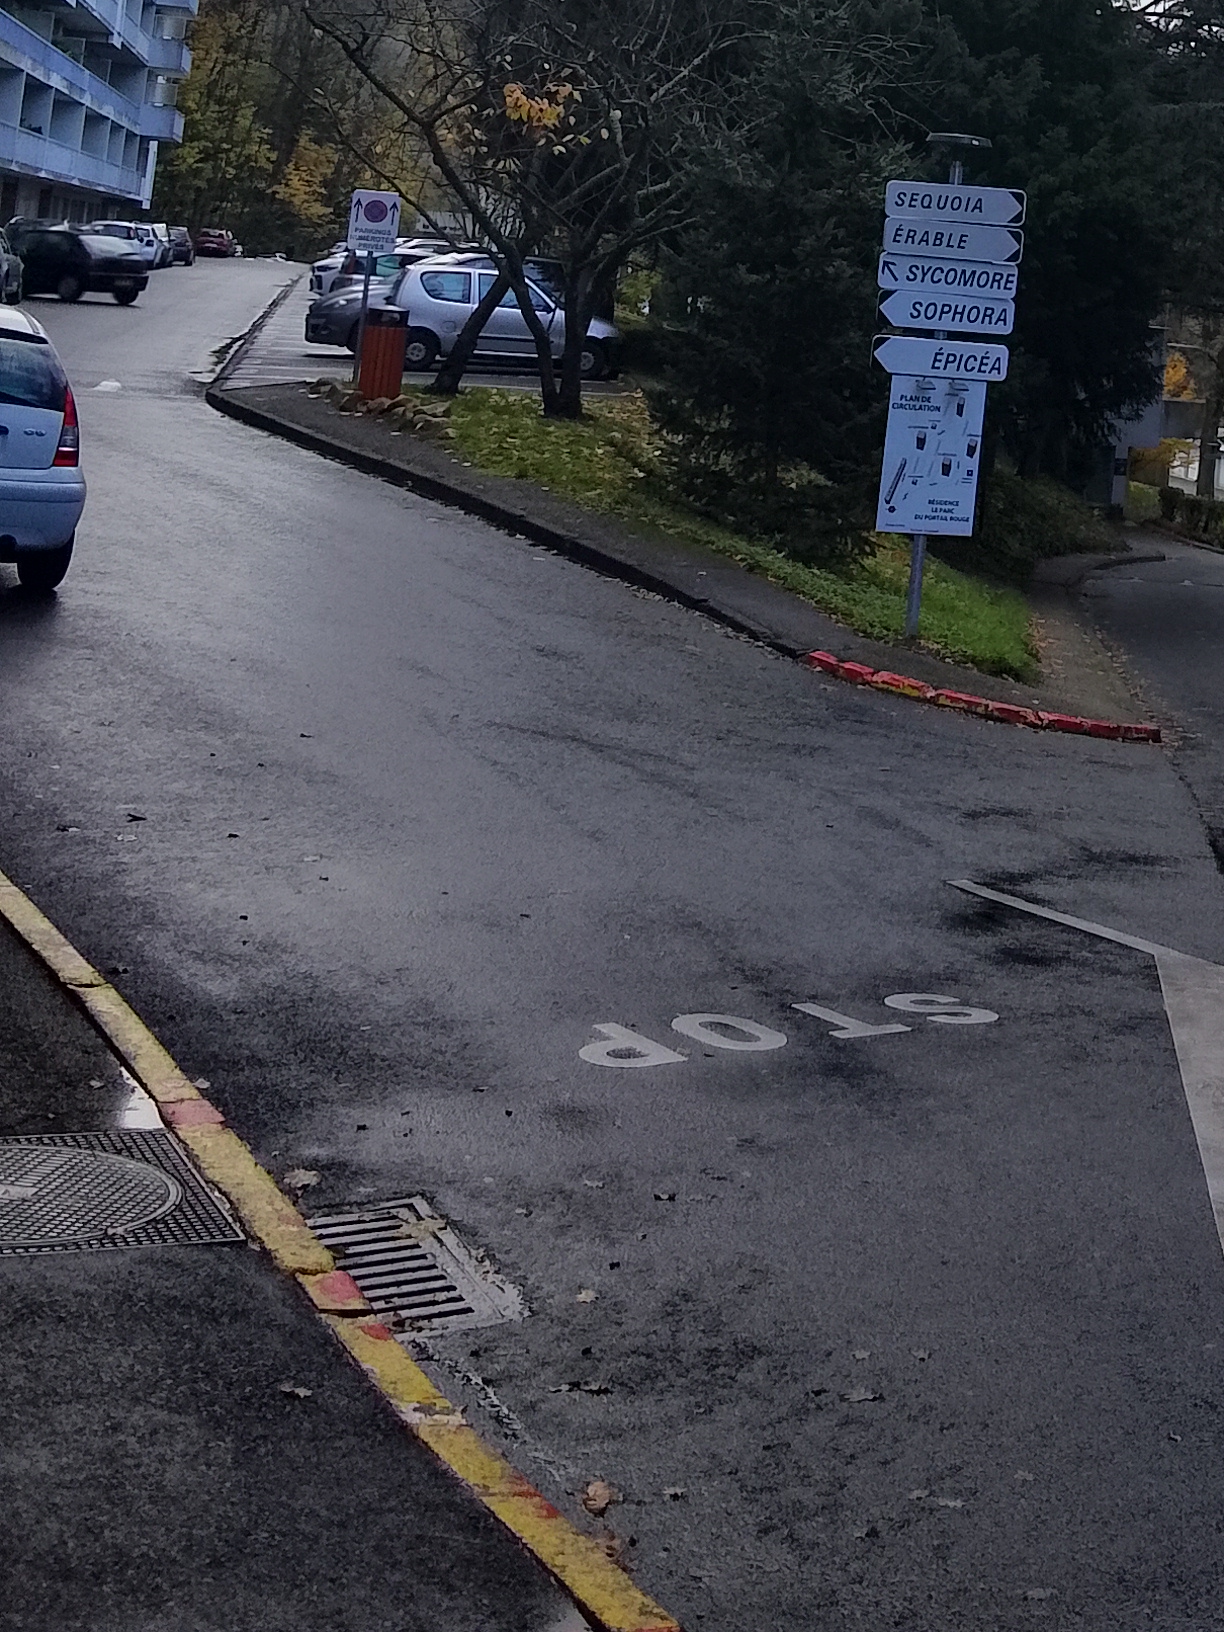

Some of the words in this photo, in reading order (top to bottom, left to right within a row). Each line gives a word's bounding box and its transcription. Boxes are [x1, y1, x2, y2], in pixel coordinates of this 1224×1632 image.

[894, 192, 983, 213] SEQUOIA
[892, 224, 969, 250] ÉRABLE
[906, 264, 1016, 291] SYCOMORE
[909, 301, 1008, 327] SOPHORA
[930, 347, 1002, 376] ÉPICÉA
[892, 402, 942, 413] CIRCULATION
[900, 394, 919, 403] PLAN
[921, 396, 932, 404] DE
[578, 992, 1000, 1068] STOP
